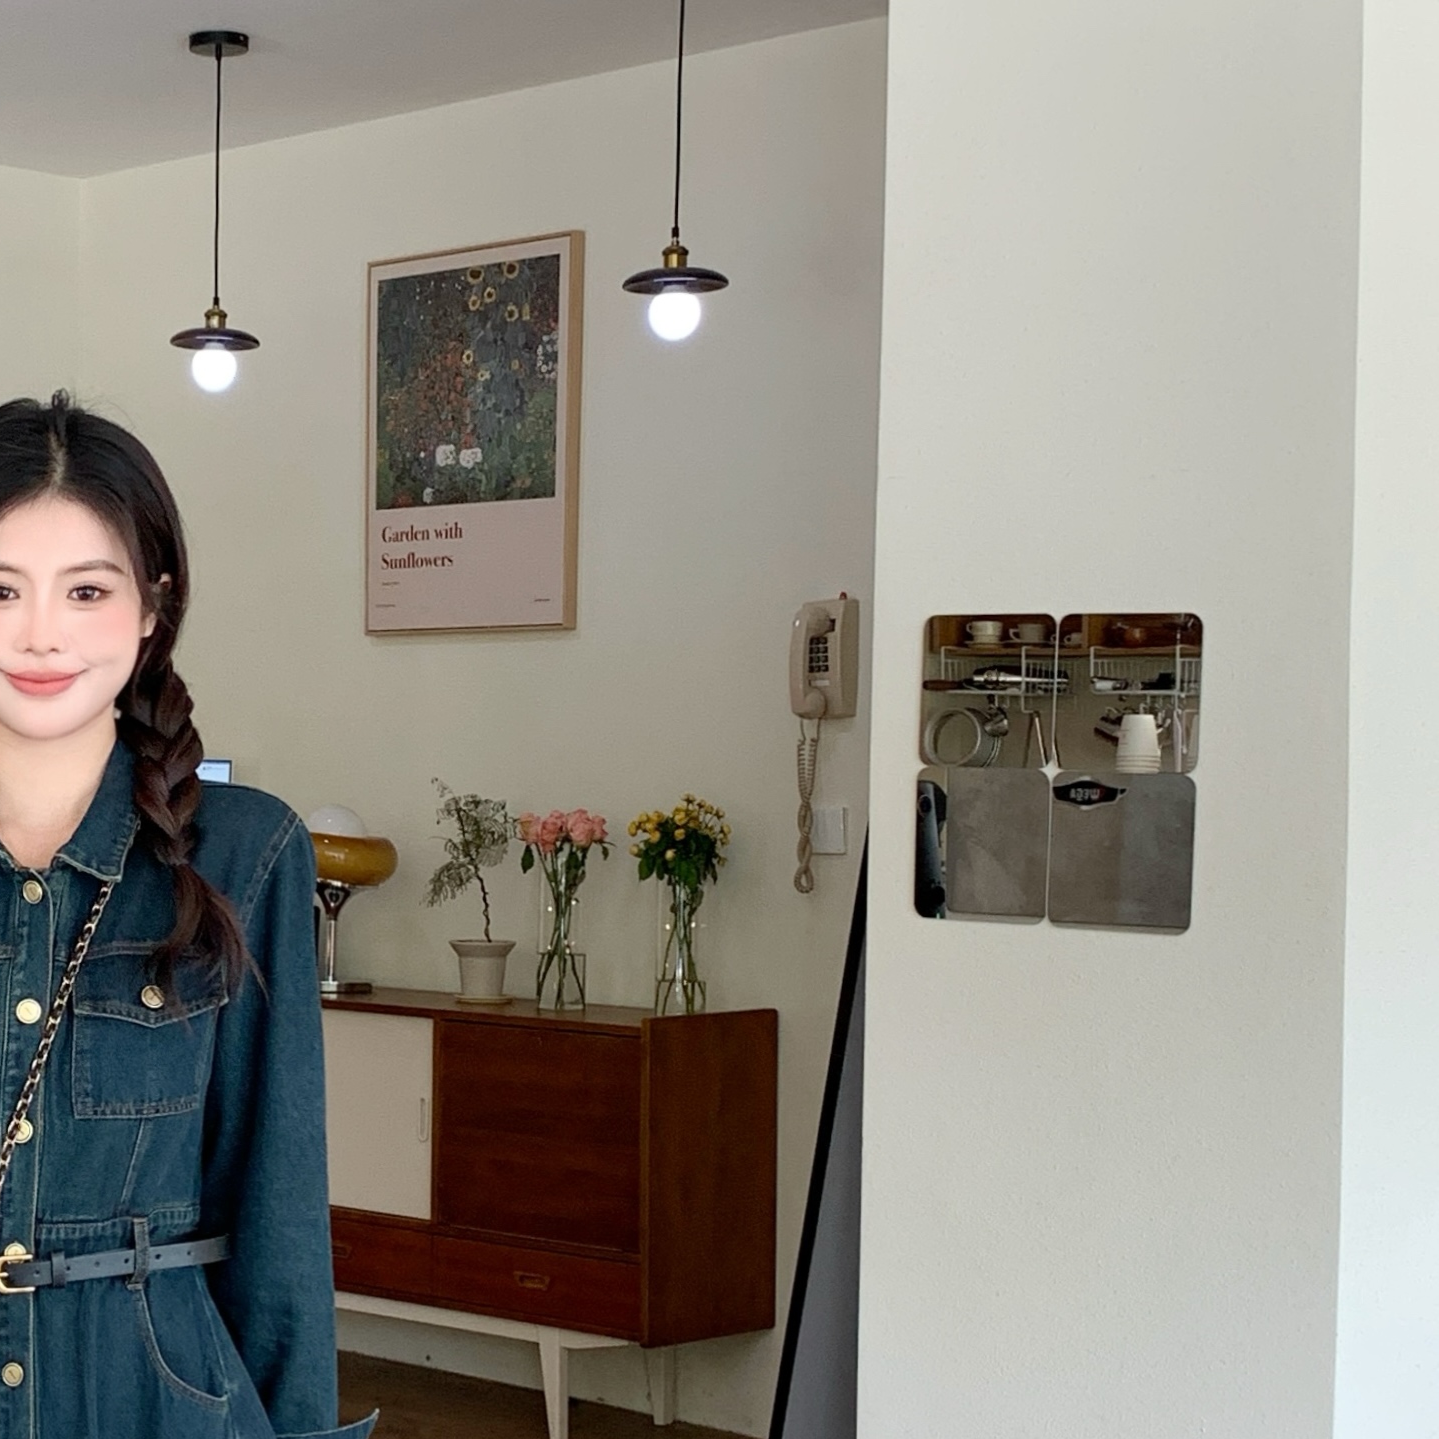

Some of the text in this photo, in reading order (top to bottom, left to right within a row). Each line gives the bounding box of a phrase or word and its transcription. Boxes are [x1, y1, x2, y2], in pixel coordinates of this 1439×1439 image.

[381, 521, 463, 543] Garden with
[381, 551, 454, 570] Sunflowers
